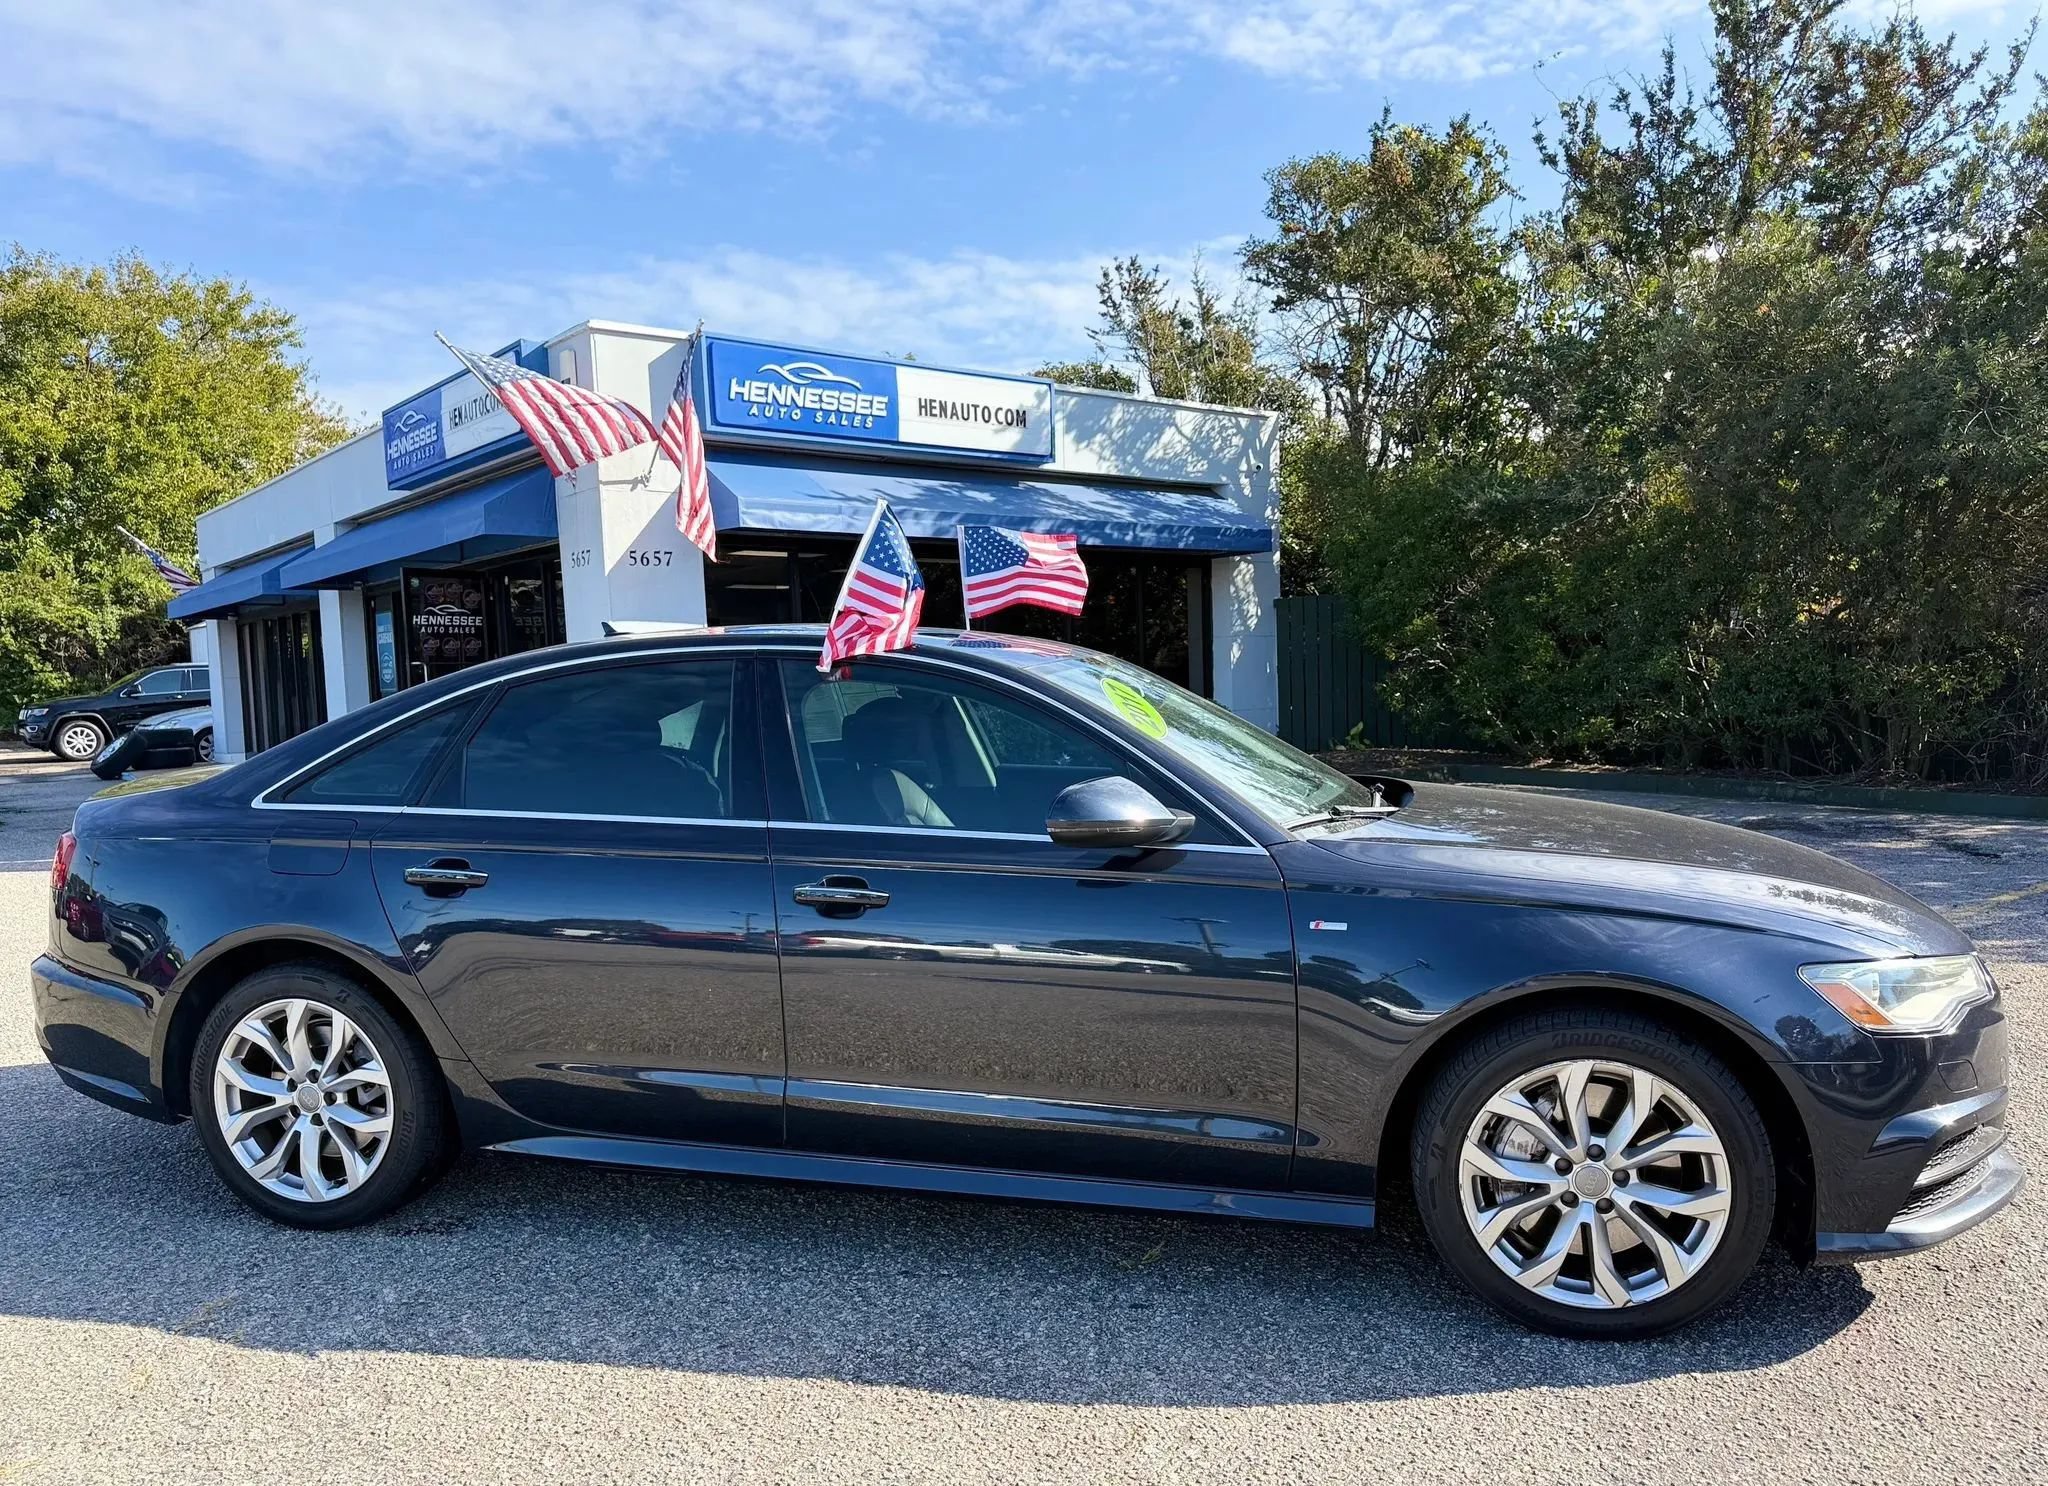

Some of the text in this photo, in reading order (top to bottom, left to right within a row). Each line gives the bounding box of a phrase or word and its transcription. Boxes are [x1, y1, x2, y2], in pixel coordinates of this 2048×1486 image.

[729, 377, 888, 417] HENNESSEE
[749, 404, 873, 428] AUTO SALES
[917, 397, 1027, 428] HENAUTO.COM
[387, 421, 438, 461] HENNESSEE
[393, 446, 435, 470] AUTO SALES
[571, 549, 591, 568] 5657
[628, 550, 673, 567] 5657
[412, 614, 483, 626] HENNESSEE
[448, 626, 475, 634] SALES
[193, 1001, 233, 1093] BRIDGESTONE
[1551, 1032, 1689, 1073] BRIDGESTONE
